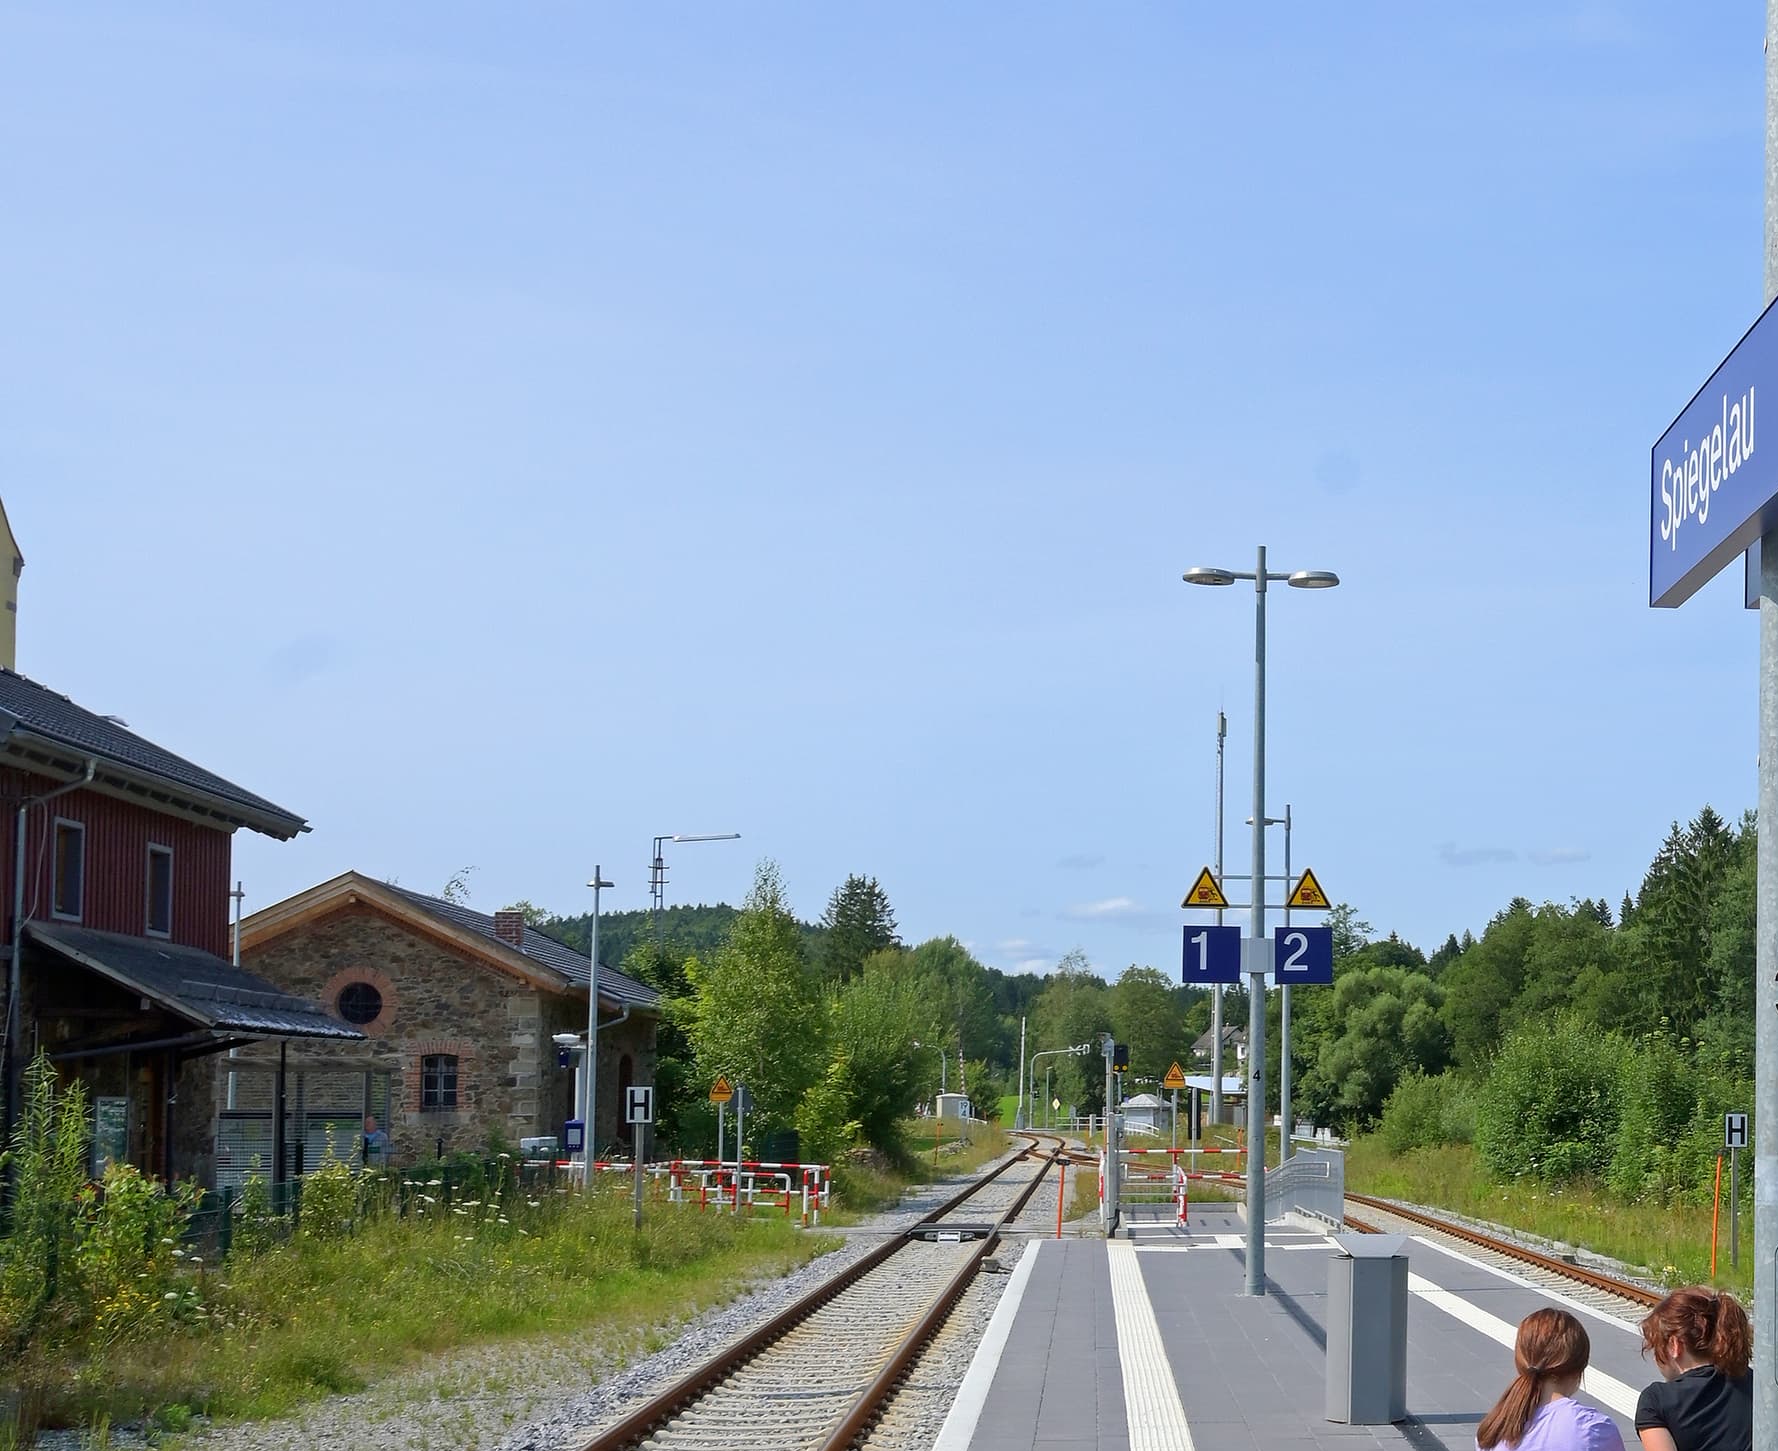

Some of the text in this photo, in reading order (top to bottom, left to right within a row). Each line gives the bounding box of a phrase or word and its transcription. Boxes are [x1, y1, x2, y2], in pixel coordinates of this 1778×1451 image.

[1660, 385, 1755, 551] Spiegelau
[1191, 931, 1208, 970] 1
[1283, 932, 1309, 972] 2
[1253, 1069, 1261, 1081] 4
[629, 1089, 651, 1121] H
[1727, 1116, 1746, 1145] H
